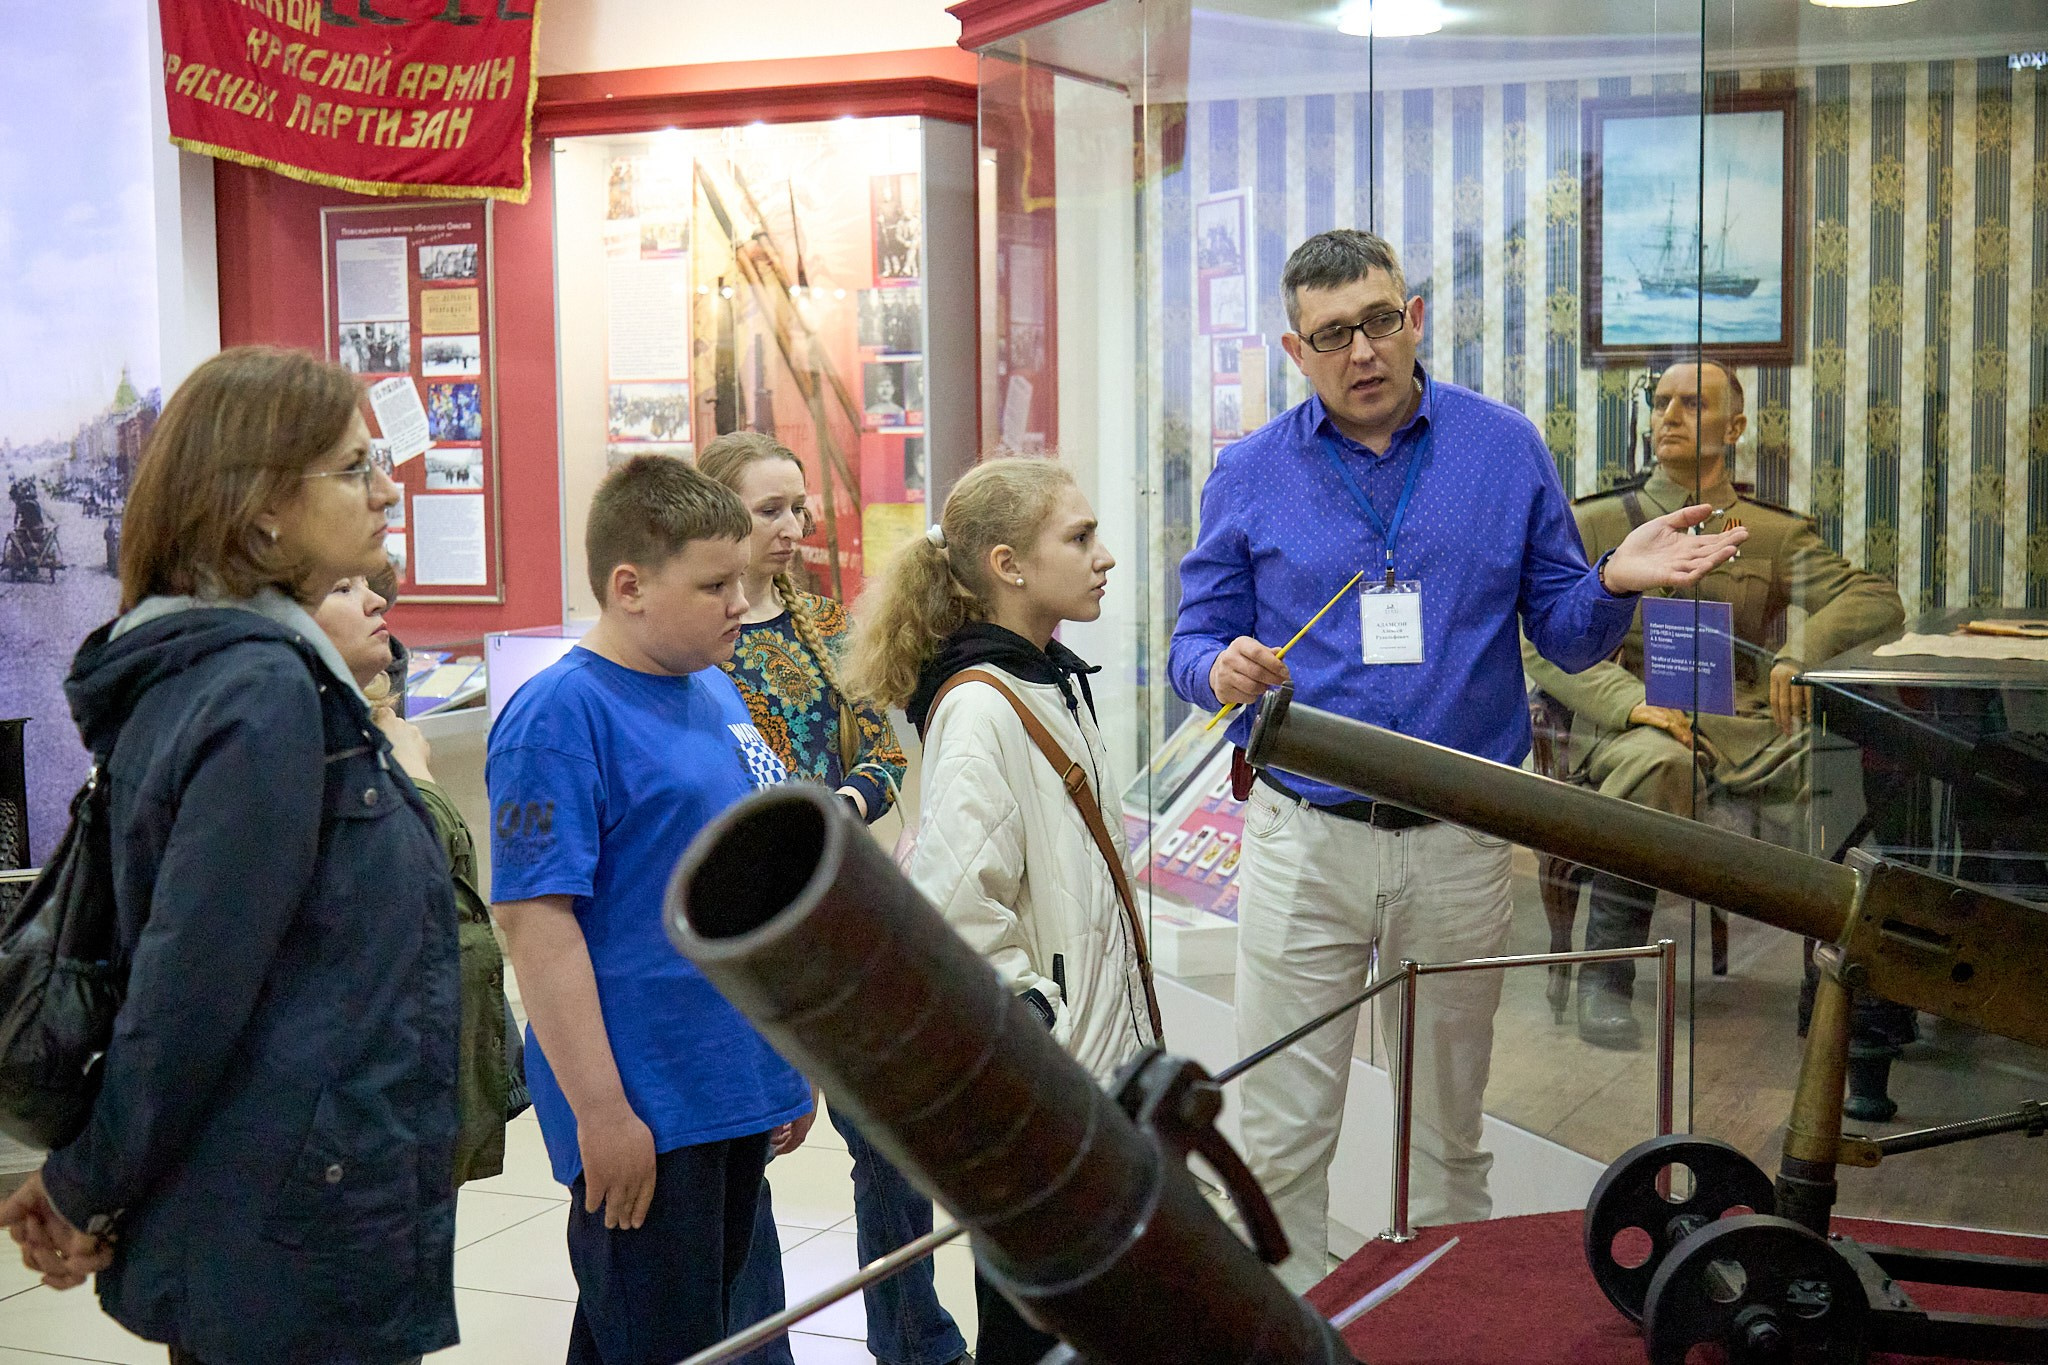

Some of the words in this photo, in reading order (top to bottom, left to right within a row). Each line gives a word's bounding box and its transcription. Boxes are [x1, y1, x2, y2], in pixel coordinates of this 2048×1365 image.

[163, 50, 279, 122] РАСНЫХ
[286, 94, 473, 149] ПАРТИЗАН
[246, 27, 392, 96] КРАСНОЙ
[396, 56, 516, 101] АРМИИ
